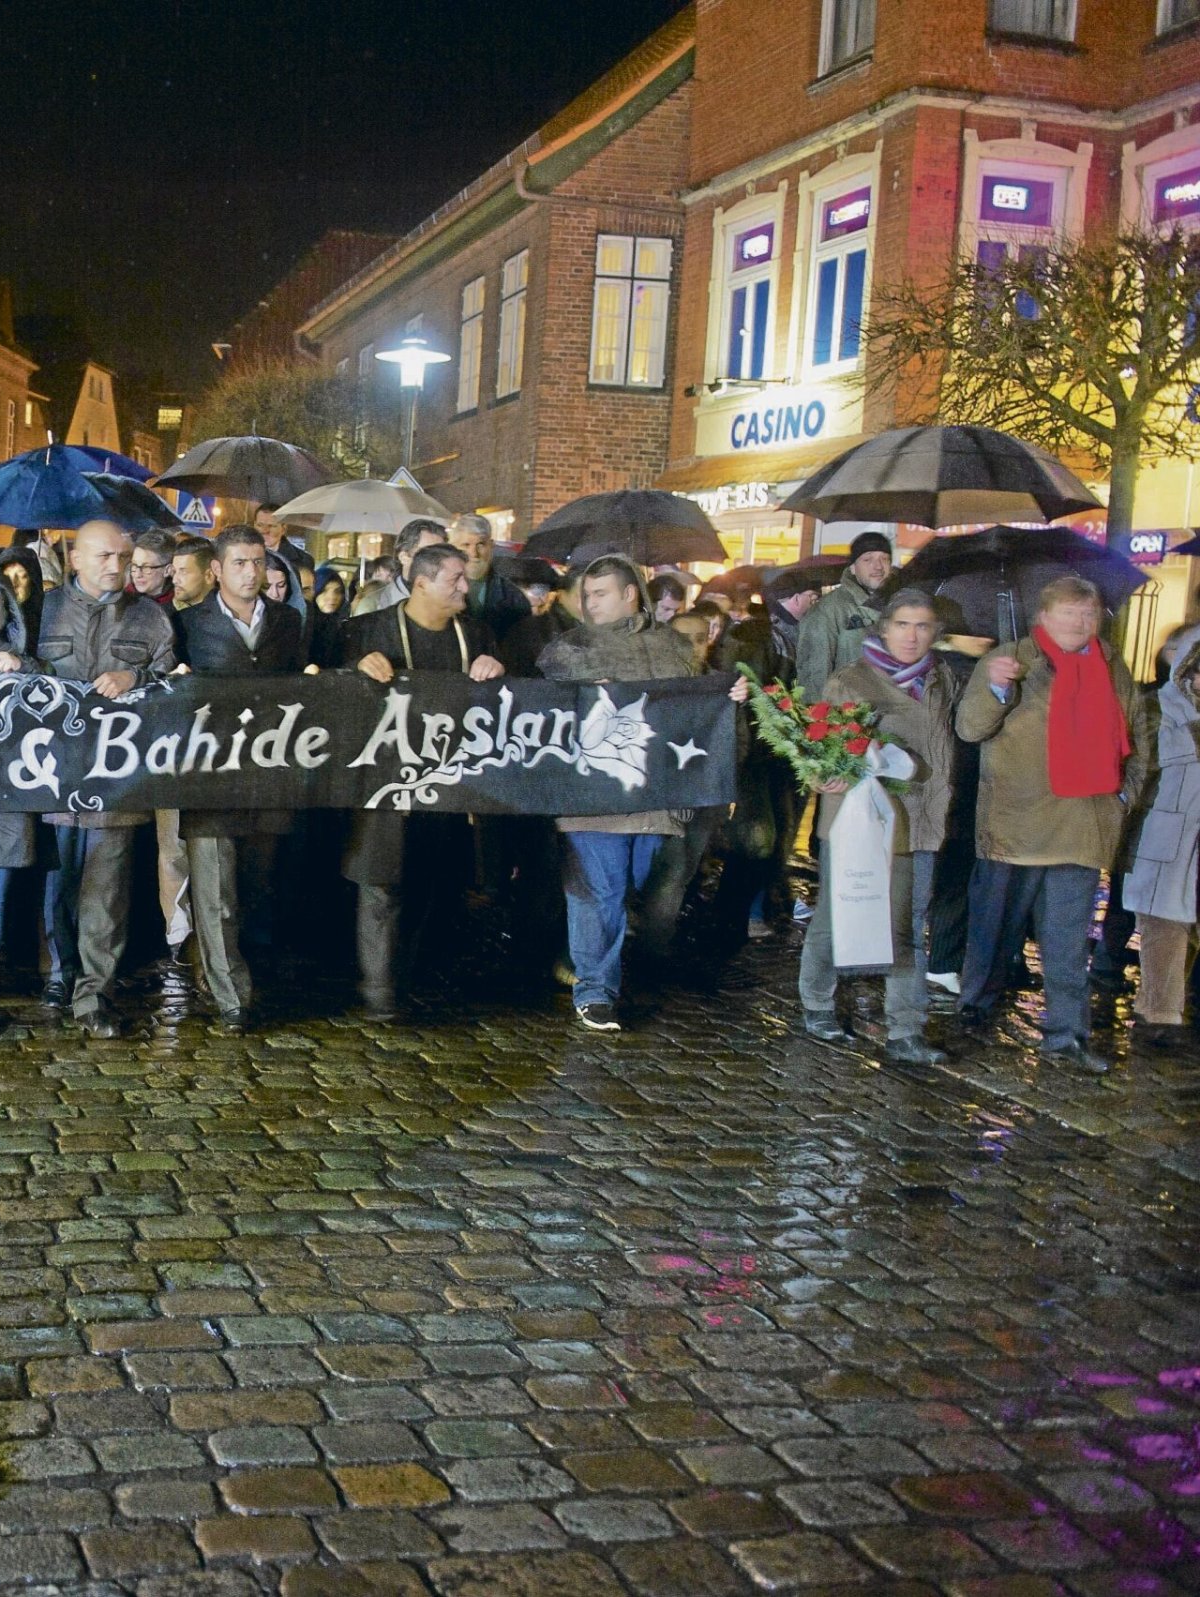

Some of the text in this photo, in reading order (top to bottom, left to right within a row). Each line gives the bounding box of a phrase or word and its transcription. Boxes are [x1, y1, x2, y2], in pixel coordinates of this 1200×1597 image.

[731, 400, 825, 449] CASINO
[736, 482, 768, 508] EIS
[1130, 533, 1163, 553] OPEN
[8, 727, 60, 799] &
[83, 702, 331, 780] Bahide
[346, 684, 576, 768] Arslan
